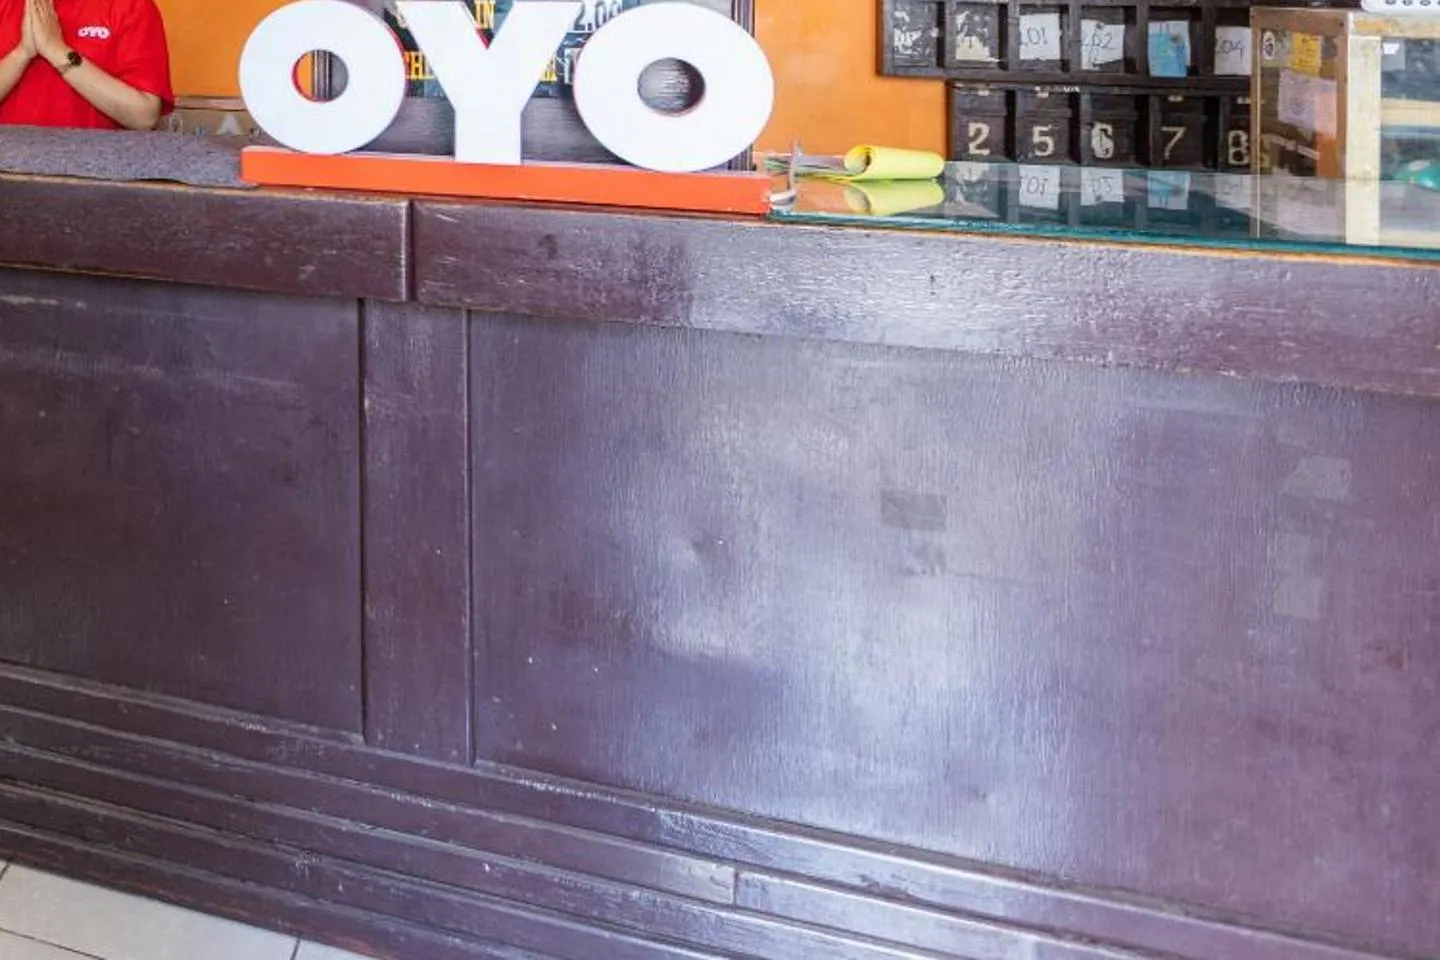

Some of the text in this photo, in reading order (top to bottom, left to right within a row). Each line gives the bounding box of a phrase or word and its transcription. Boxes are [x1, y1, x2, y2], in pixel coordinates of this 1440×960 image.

[77, 26, 111, 39] OYO
[967, 122, 991, 156] 2
[1032, 125, 1056, 157] 5
[1161, 126, 1187, 160] 7
